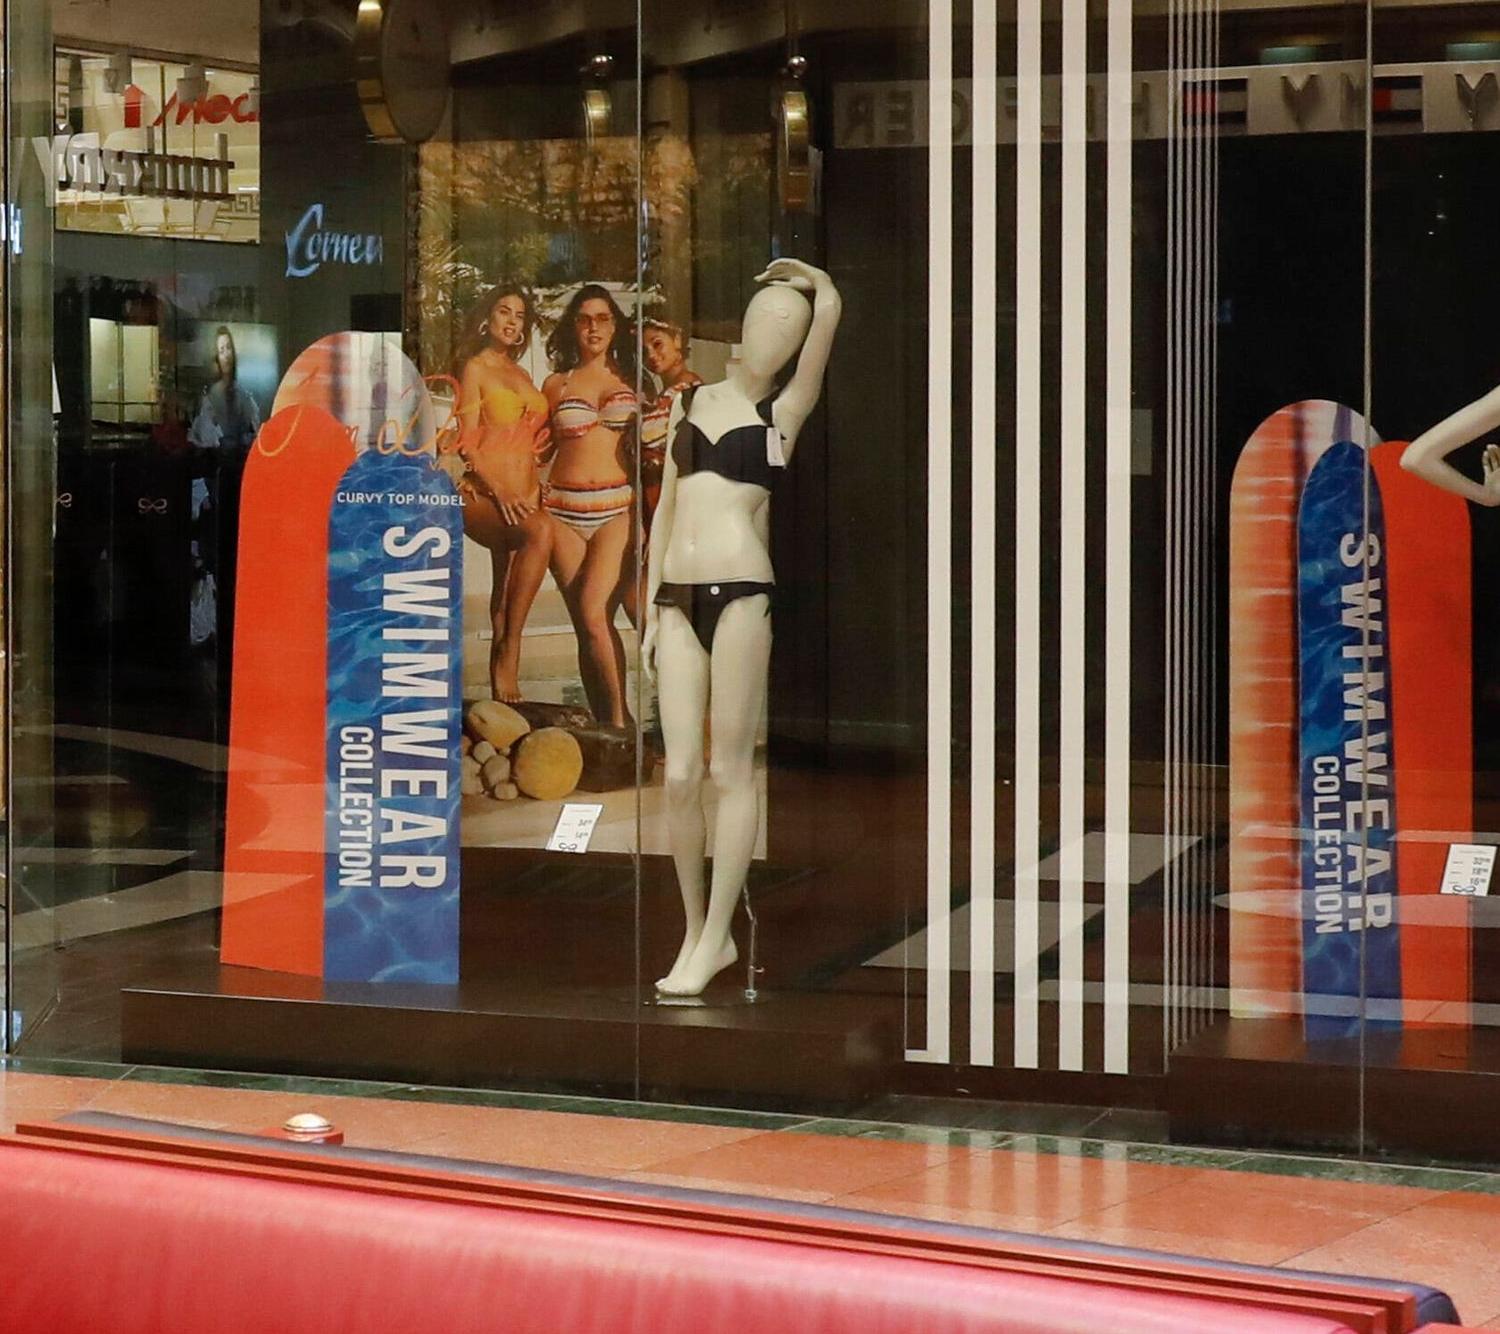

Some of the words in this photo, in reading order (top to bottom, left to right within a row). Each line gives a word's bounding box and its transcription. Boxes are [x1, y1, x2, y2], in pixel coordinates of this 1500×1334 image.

[336, 492, 383, 504] CURVY
[388, 493, 415, 505] TOP
[418, 494, 467, 507] MODEL
[379, 524, 452, 891] SWIMWEAR
[1338, 531, 1394, 933] SWIMWEAR
[338, 725, 374, 889] COLLECTION
[1311, 754, 1343, 936] COLLECTION
